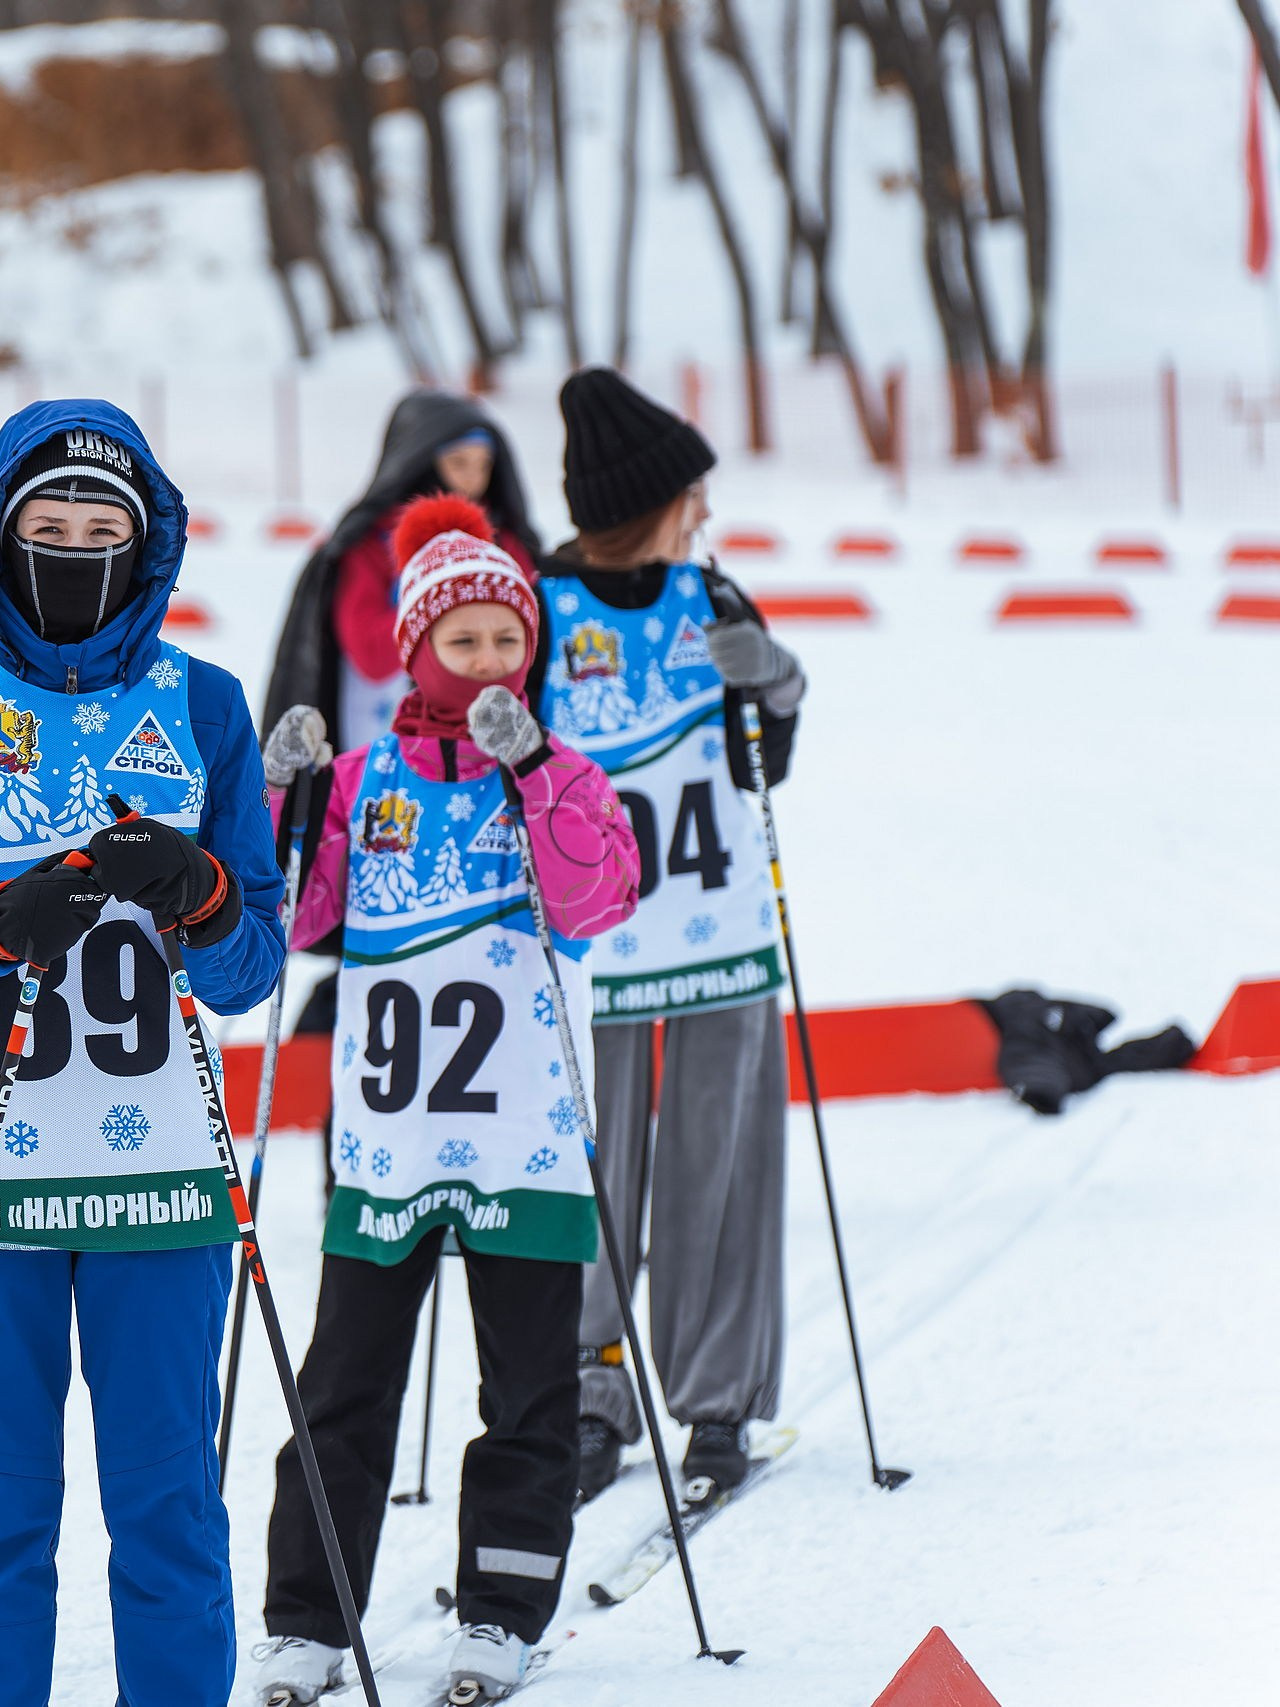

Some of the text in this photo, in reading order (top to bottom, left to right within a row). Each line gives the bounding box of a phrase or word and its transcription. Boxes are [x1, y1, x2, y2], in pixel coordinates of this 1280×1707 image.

[67, 449, 102, 461] DESIGN
[114, 459, 133, 478] ITALY
[114, 756, 183, 776] СТРОЙ
[120, 745, 177, 763] МЕГА
[108, 831, 151, 842] reusch
[361, 979, 505, 1113] 92
[186, 1022, 237, 1180] VUOKATTI
[7, 1181, 213, 1230] «НАГОРНЫЙ»
[242, 1238, 266, 1286] A7
